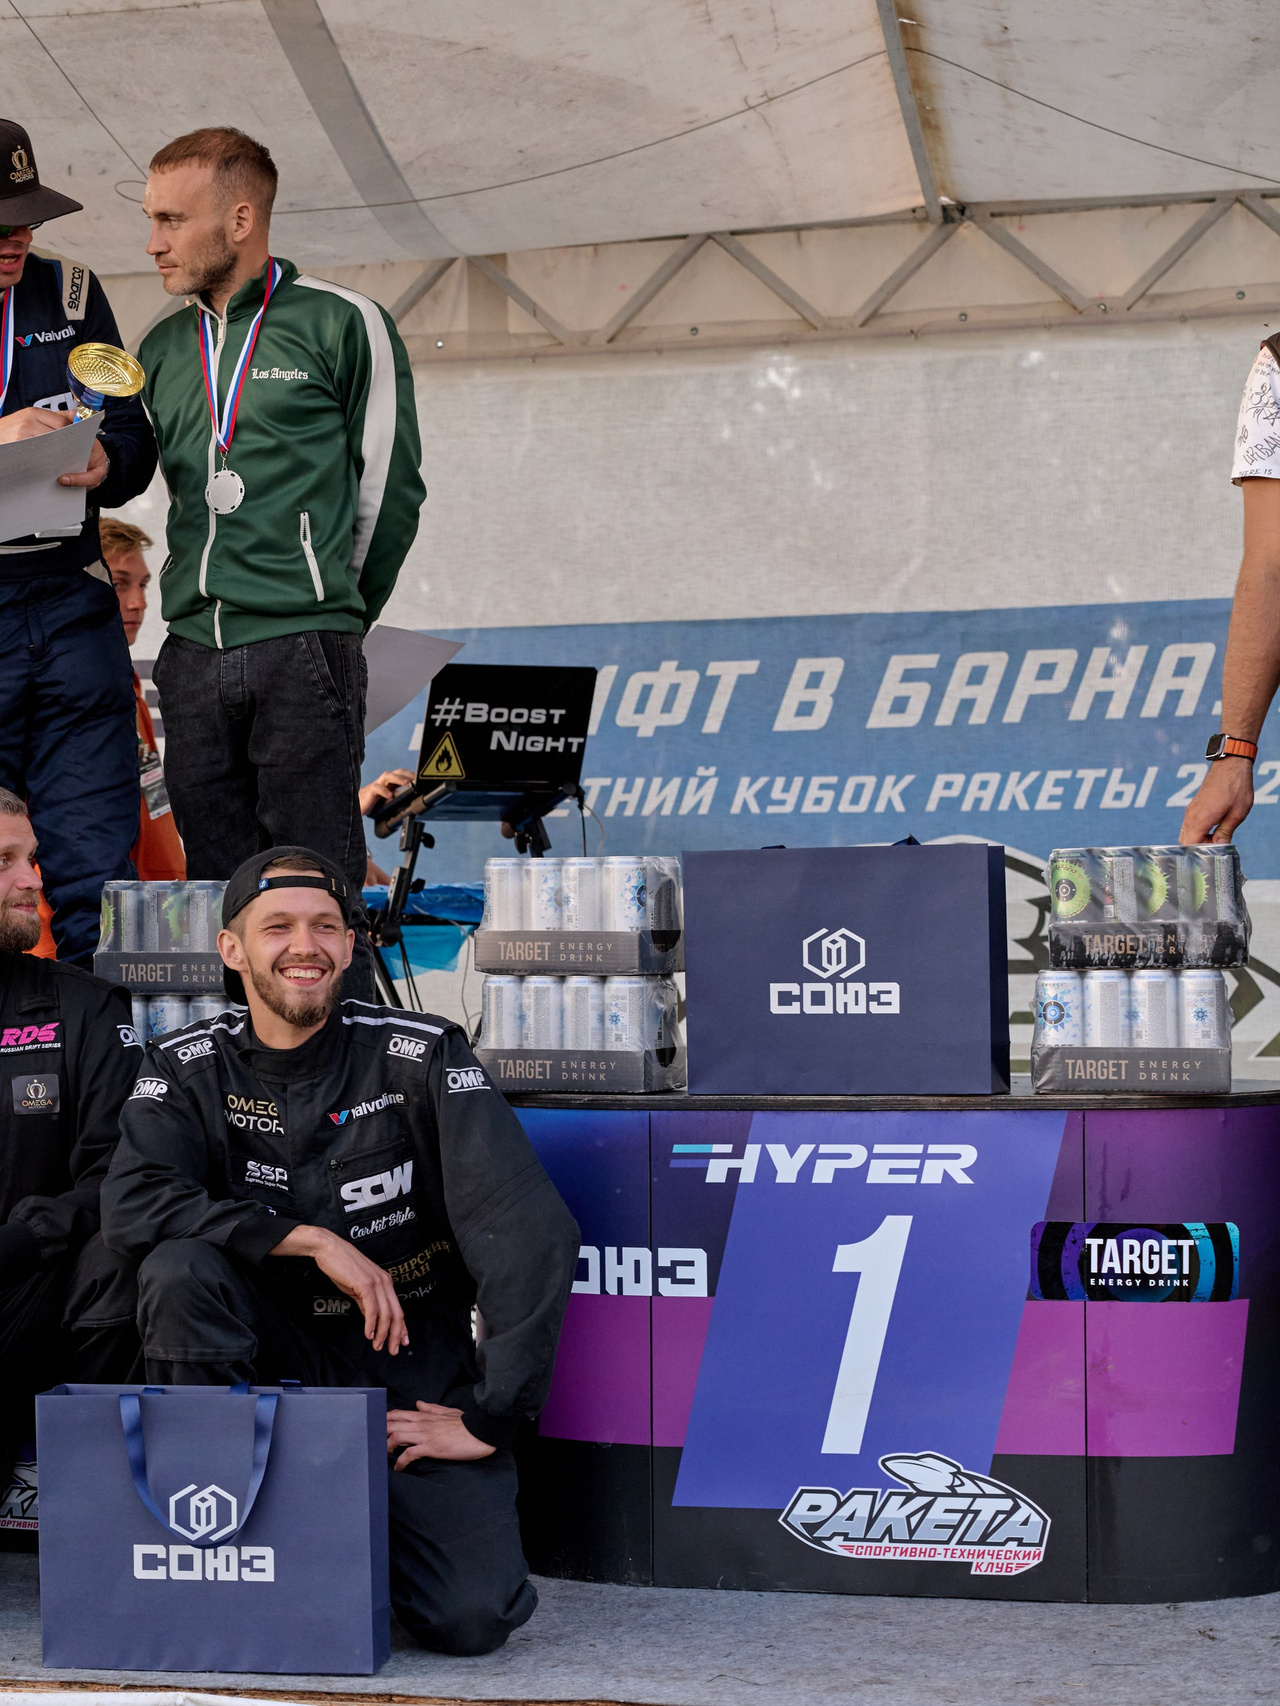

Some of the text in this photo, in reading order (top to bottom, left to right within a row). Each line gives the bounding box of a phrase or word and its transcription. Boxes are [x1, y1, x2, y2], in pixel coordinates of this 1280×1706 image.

[9, 167, 35, 180] OMEGA
[68, 267, 84, 311] sparco
[35, 325, 76, 343] Valvoli
[251, 367, 308, 380] Los Angeles
[772, 656, 845, 731] В
[866, 642, 1222, 729] БАРНА
[730, 774, 916, 814] КУБОК
[925, 766, 1159, 812] РАКЕТЫ
[498, 941, 613, 961] TARGET ENERGY
[1083, 934, 1219, 955] TARGET ENERGY
[1157, 945, 1209, 954] DRINK
[560, 953, 603, 962] DRINK
[120, 963, 224, 983] TARGET ENERG
[770, 982, 900, 1015] СОЮЗ
[0, 1022, 60, 1046] RDS
[177, 1040, 214, 1061] OMP
[389, 1038, 426, 1058] OMP
[447, 1070, 485, 1089] OMP
[498, 1059, 617, 1080] TARGET ENERGY
[561, 1072, 606, 1081] DRINK
[1065, 1059, 1202, 1080] TARGET ENERGY
[1139, 1072, 1190, 1081] DRINK
[133, 1081, 168, 1096] OMP
[21, 1099, 53, 1107] OMEGA
[228, 1094, 278, 1117] OMEG
[224, 1109, 285, 1134] MOTOR
[246, 1160, 288, 1183] SSP
[705, 1144, 978, 1184] HYPER
[340, 1159, 414, 1213] SCW
[1085, 1238, 1195, 1275] TARGET
[571, 1245, 708, 1298] ОЮЗ
[1090, 1278, 1190, 1287] ENERGY DRINK
[313, 1298, 351, 1314] OMP
[820, 1214, 913, 1455] 1
[785, 1490, 1045, 1545] РАКЕТА
[133, 1544, 275, 1582] СОЮЗ
[854, 1544, 1042, 1562] СПОРТИВНО-ТЕХНИЧЕСКИЙ
[974, 1561, 1015, 1574] КЛУБ
